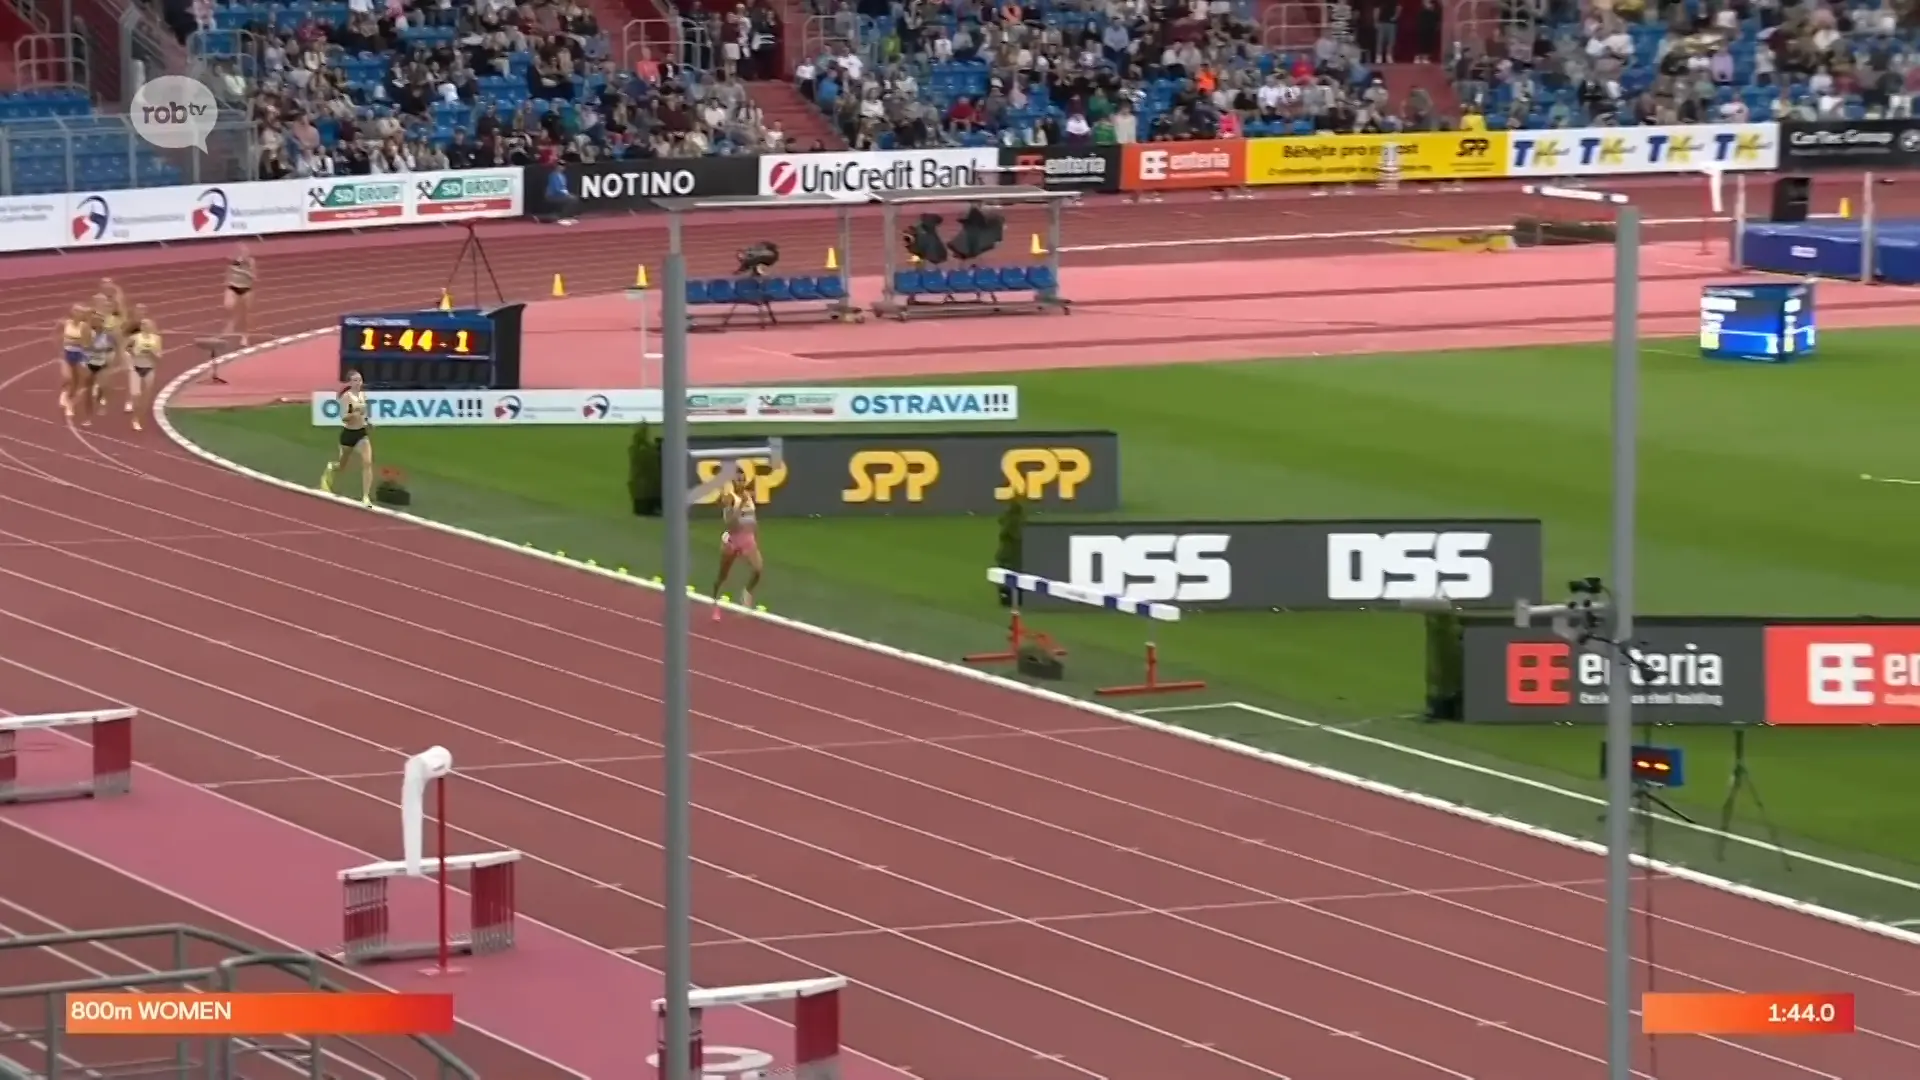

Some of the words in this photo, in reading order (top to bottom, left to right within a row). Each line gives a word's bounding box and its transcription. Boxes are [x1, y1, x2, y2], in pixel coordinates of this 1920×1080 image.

[1170, 148, 1230, 169] enteria
[1341, 146, 1367, 160] pro
[1455, 139, 1490, 157] SPP
[802, 160, 912, 194] UniCredit
[1045, 153, 1106, 175] enteria
[581, 170, 696, 199] NOTINO
[322, 398, 483, 419] OTRAVA!!!
[851, 393, 1010, 415] OSTRAVA!!!
[842, 450, 940, 503] SPP
[994, 448, 1092, 501] SPP
[1068, 534, 1231, 601] DSS
[1327, 532, 1492, 601] DSS
[1578, 642, 1723, 686] eteria
